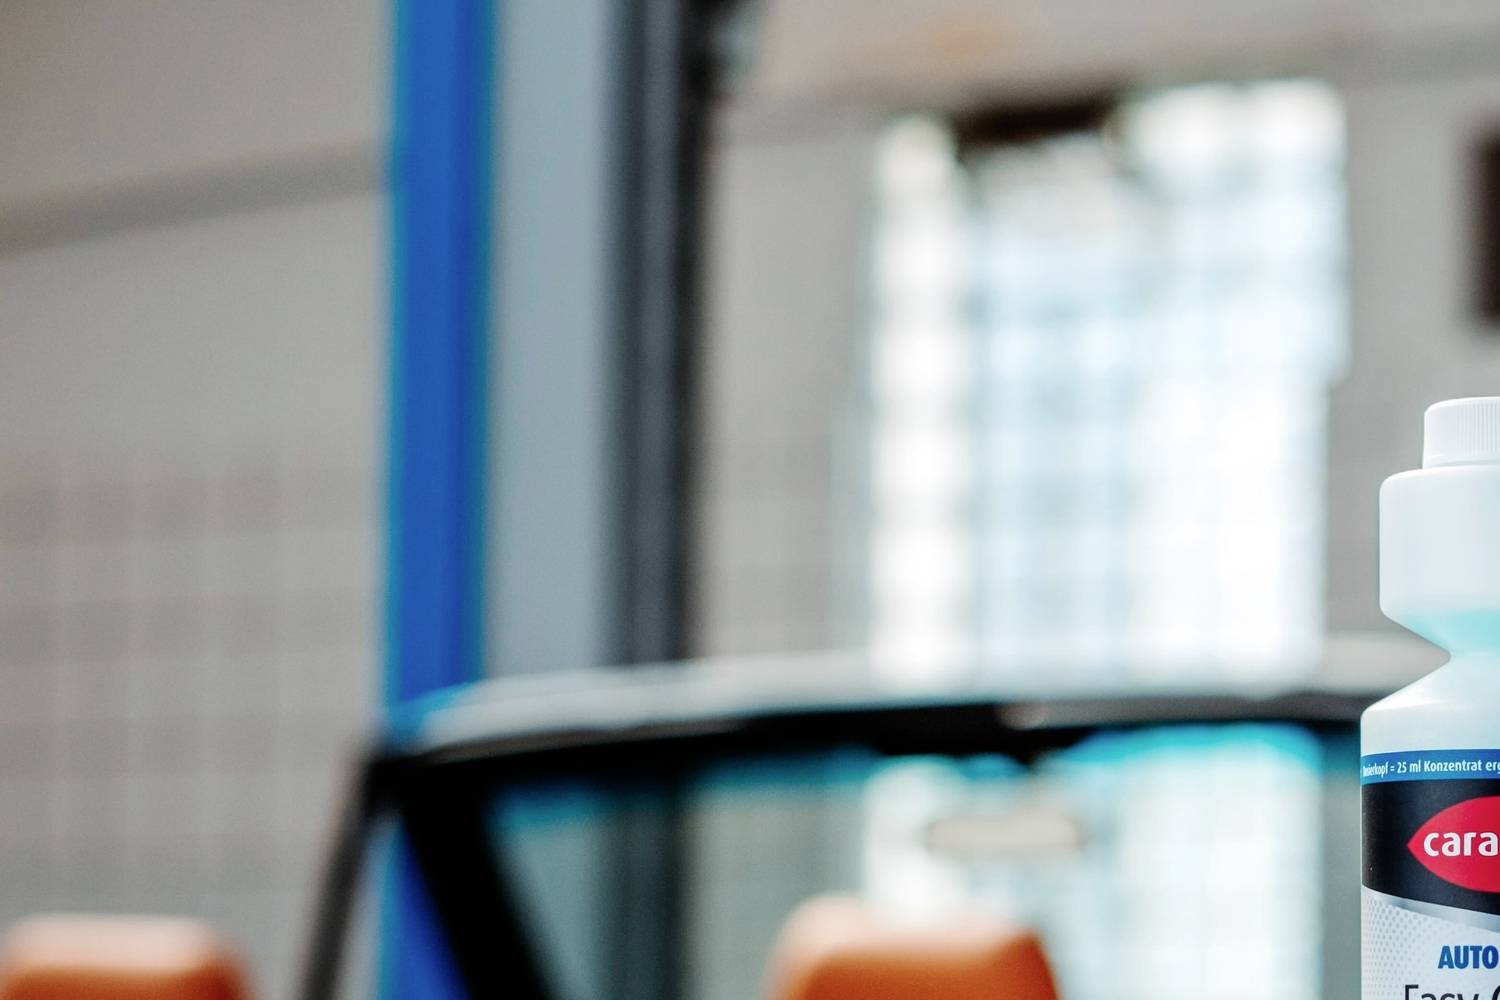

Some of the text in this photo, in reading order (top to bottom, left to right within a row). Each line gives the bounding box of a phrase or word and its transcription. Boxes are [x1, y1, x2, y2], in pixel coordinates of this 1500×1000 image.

[1397, 763, 1407, 774] 25
[1410, 762, 1421, 772] ml
[1424, 760, 1482, 772] Konzentrat
[1438, 946, 1499, 969] AUTO
